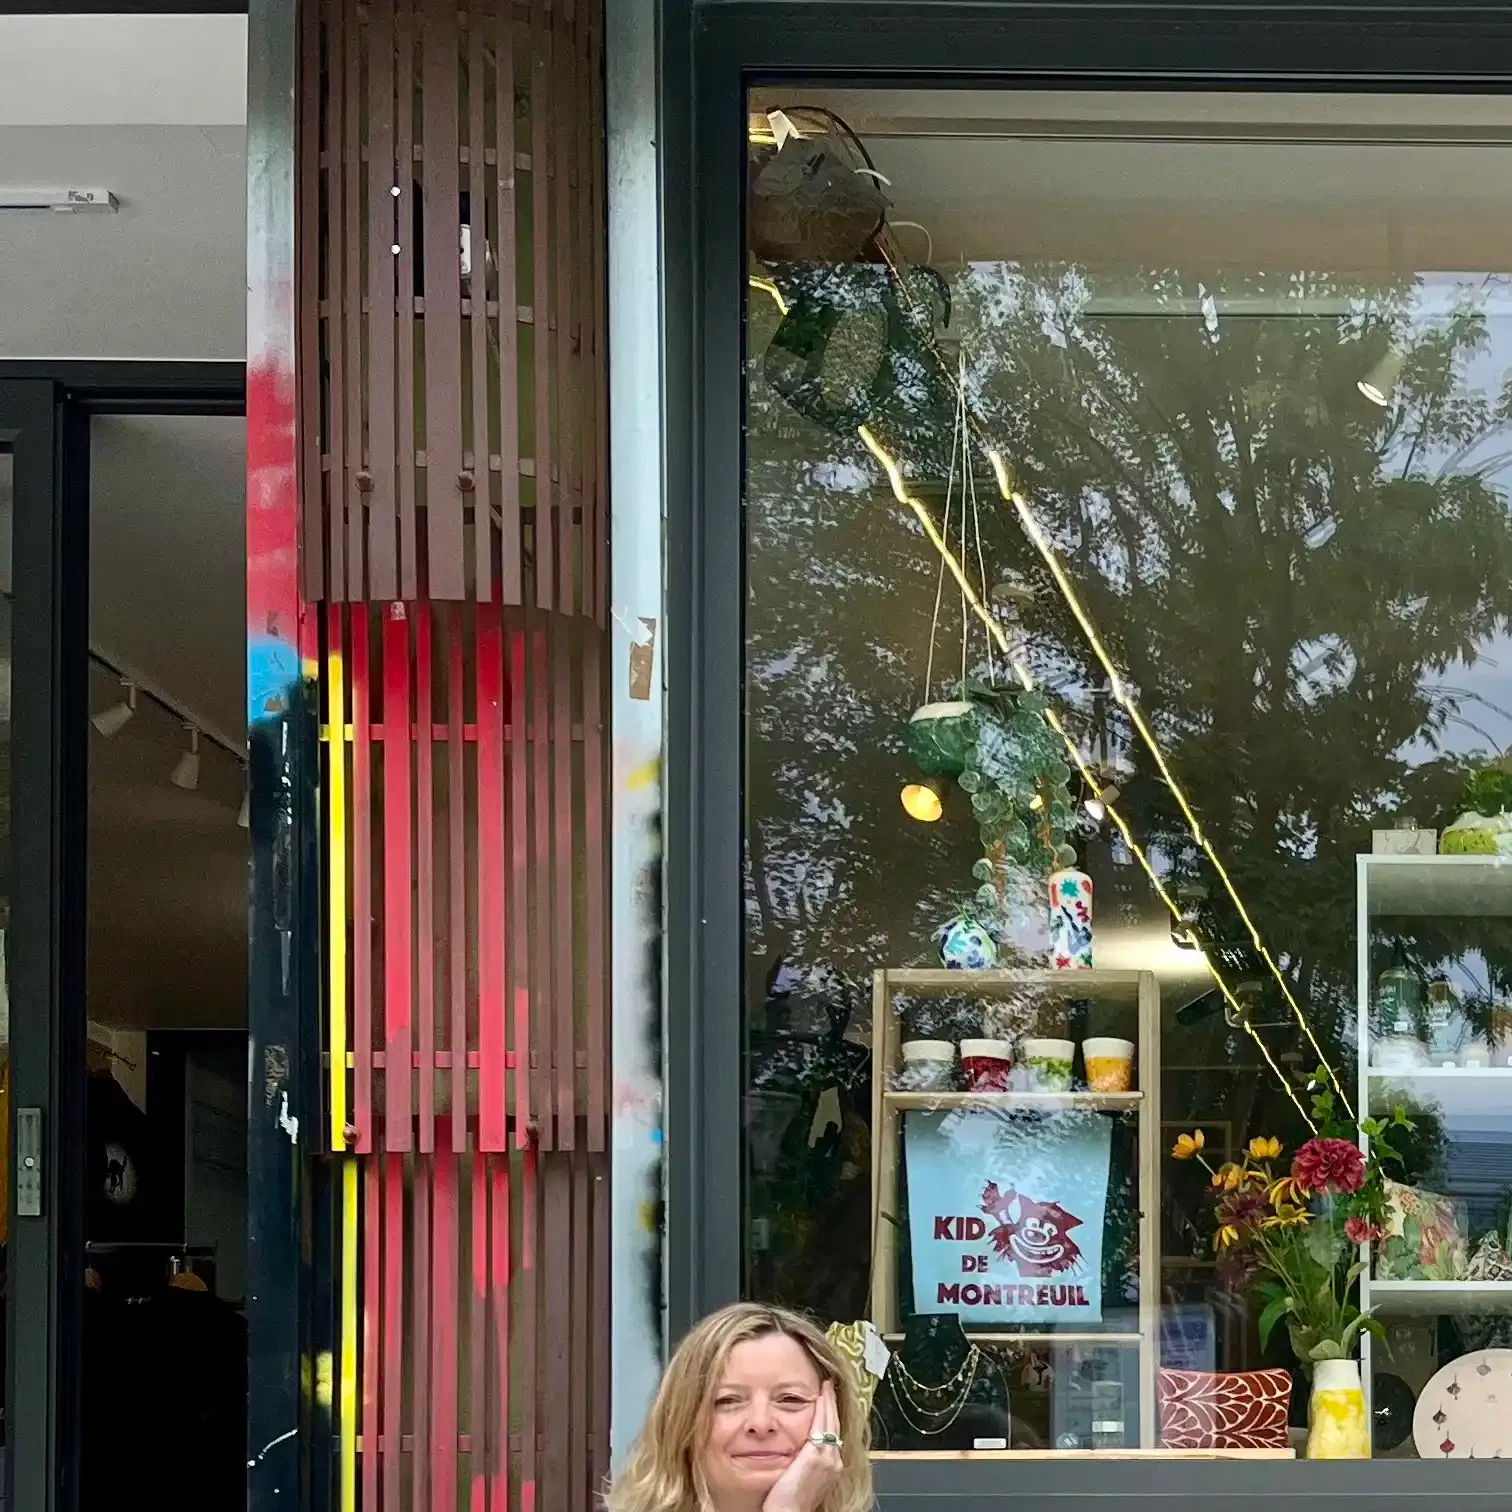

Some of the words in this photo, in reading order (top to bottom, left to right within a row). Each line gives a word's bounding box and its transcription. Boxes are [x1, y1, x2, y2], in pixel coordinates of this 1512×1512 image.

[934, 1216, 986, 1240] KID
[962, 1255, 988, 1272] DE
[937, 1283, 1089, 1305] MONTREUIL
